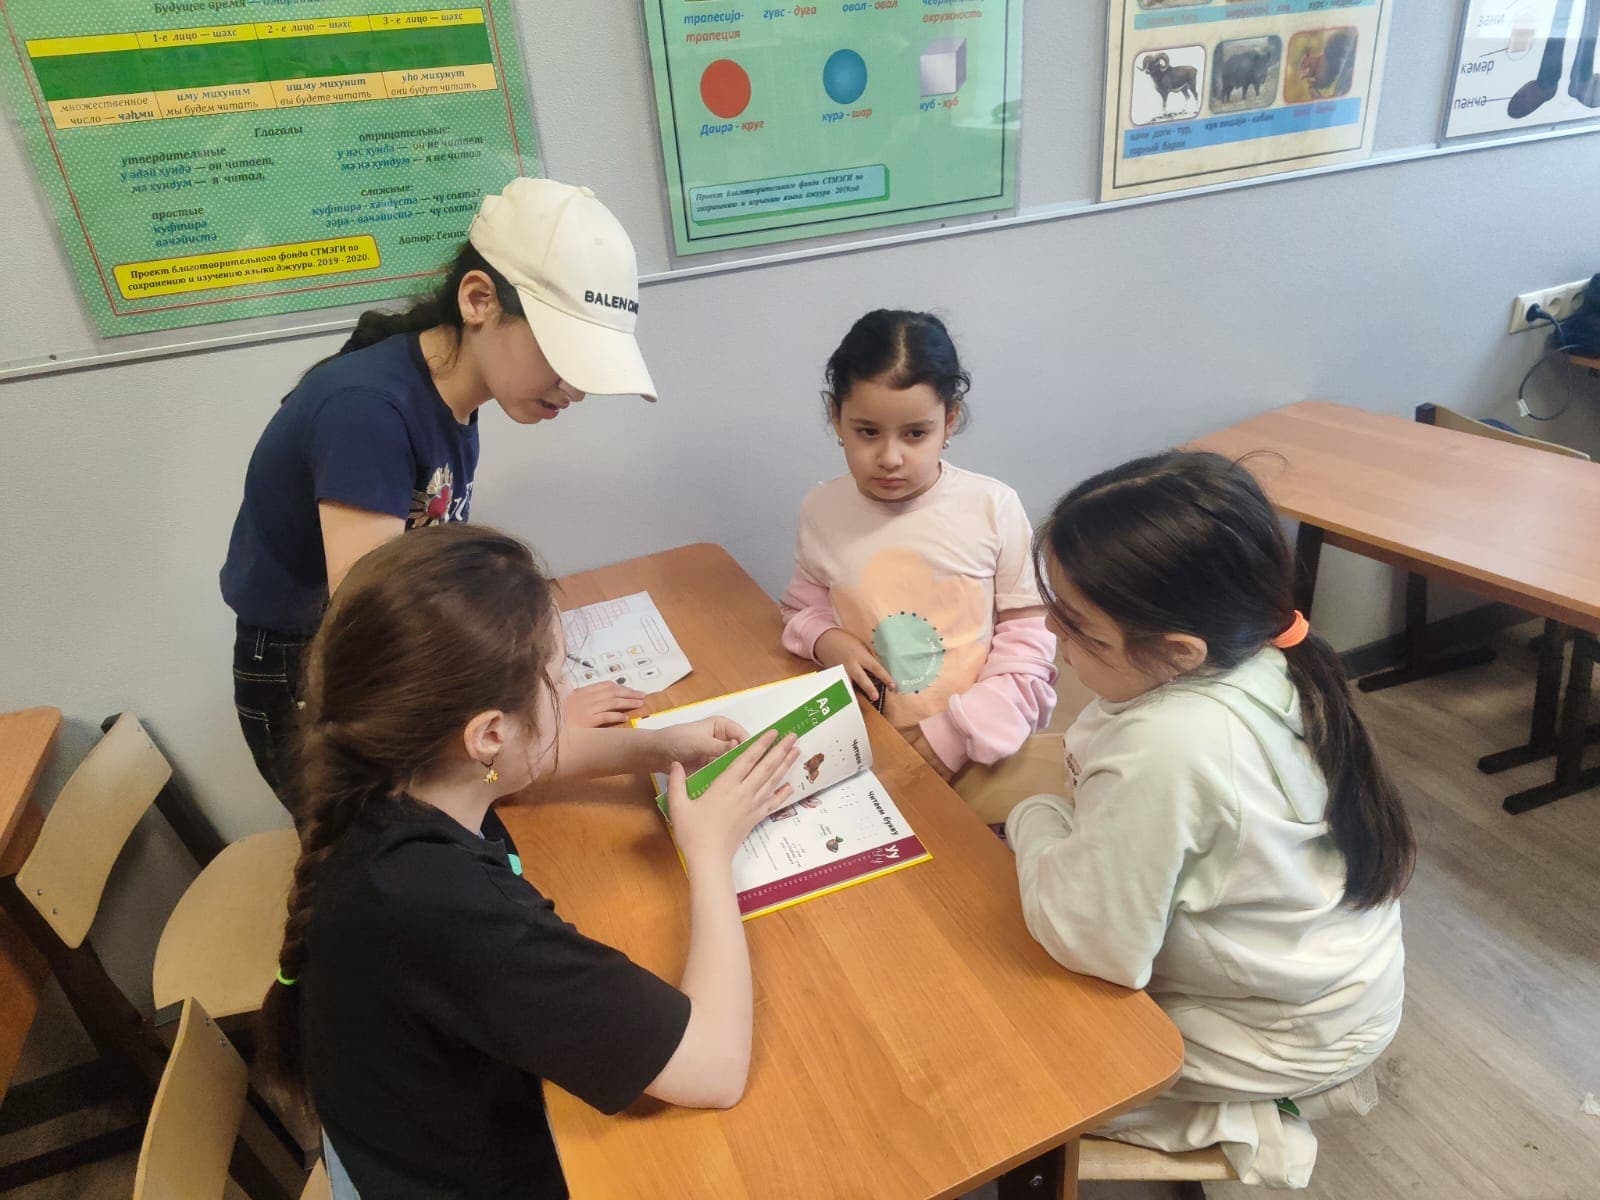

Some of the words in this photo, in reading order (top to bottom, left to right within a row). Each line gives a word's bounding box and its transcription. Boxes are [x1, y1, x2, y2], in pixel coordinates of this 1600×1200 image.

[154, 0, 206, 15] Будущее
[793, 5, 817, 19] дуга
[842, 2, 867, 12] овал
[874, 0, 898, 10] овал
[405, 14, 427, 24] лицо
[923, 10, 983, 24] окружность
[291, 22, 314, 33] лицо
[173, 31, 198, 42] лицо
[685, 30, 741, 44] трапеция
[391, 88, 407, 96] они
[409, 83, 438, 96] будут
[440, 81, 476, 92] читать
[60, 97, 148, 112] множественное
[280, 98, 295, 106] вы
[297, 94, 330, 107] будете
[333, 91, 372, 102] читать
[920, 98, 937, 111] куб
[943, 95, 959, 109] куб
[166, 107, 182, 116] мы
[184, 103, 215, 117] будем
[217, 100, 258, 112] читать
[852, 108, 873, 119] шар
[70, 115, 101, 126] число
[742, 120, 765, 132] круг
[413, 142, 425, 150] он
[427, 141, 440, 149] не
[441, 136, 483, 148] читает
[121, 147, 226, 167] утвердительные
[433, 154, 447, 162] не
[448, 150, 482, 161] читал
[209, 163, 222, 171] он
[361, 184, 414, 197] сложные:
[152, 206, 205, 221] простые
[131, 266, 170, 280] Проект
[171, 254, 277, 274] благотворительного
[278, 250, 308, 263] фонда
[310, 245, 346, 257] СТМЭГИ
[348, 245, 359, 253] по
[128, 276, 187, 291] сохранению
[188, 276, 195, 284] и
[196, 269, 242, 283] изучению
[244, 266, 275, 278] языка
[317, 257, 340, 268] 2019
[584, 289, 639, 315] BALENC
[867, 790, 886, 815] Читаем
[883, 816, 900, 836] букву
